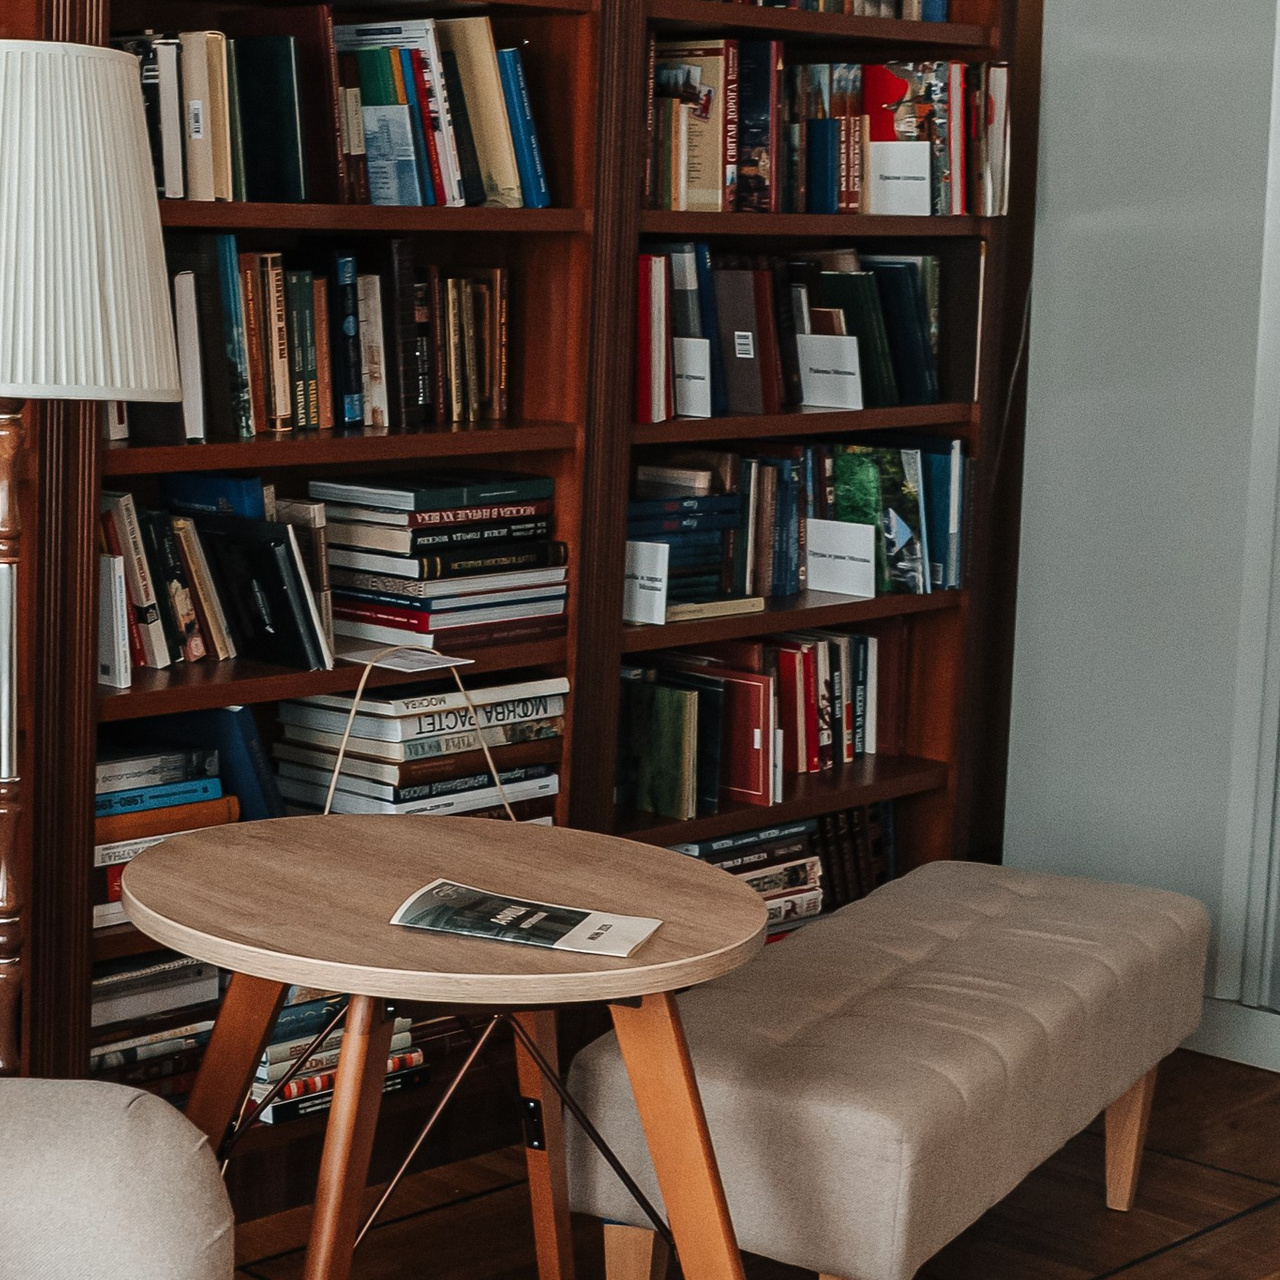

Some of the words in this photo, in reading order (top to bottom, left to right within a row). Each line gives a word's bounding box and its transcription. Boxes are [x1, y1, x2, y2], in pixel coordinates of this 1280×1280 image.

[726, 84, 738, 122] ДОРОГА
[726, 124, 738, 162] СВЯТАЯ
[416, 512, 440, 523] ВЕКА
[500, 506, 536, 519] МОСКВА
[402, 696, 446, 710] МОСКВА
[483, 699, 548, 723] МОСКВА
